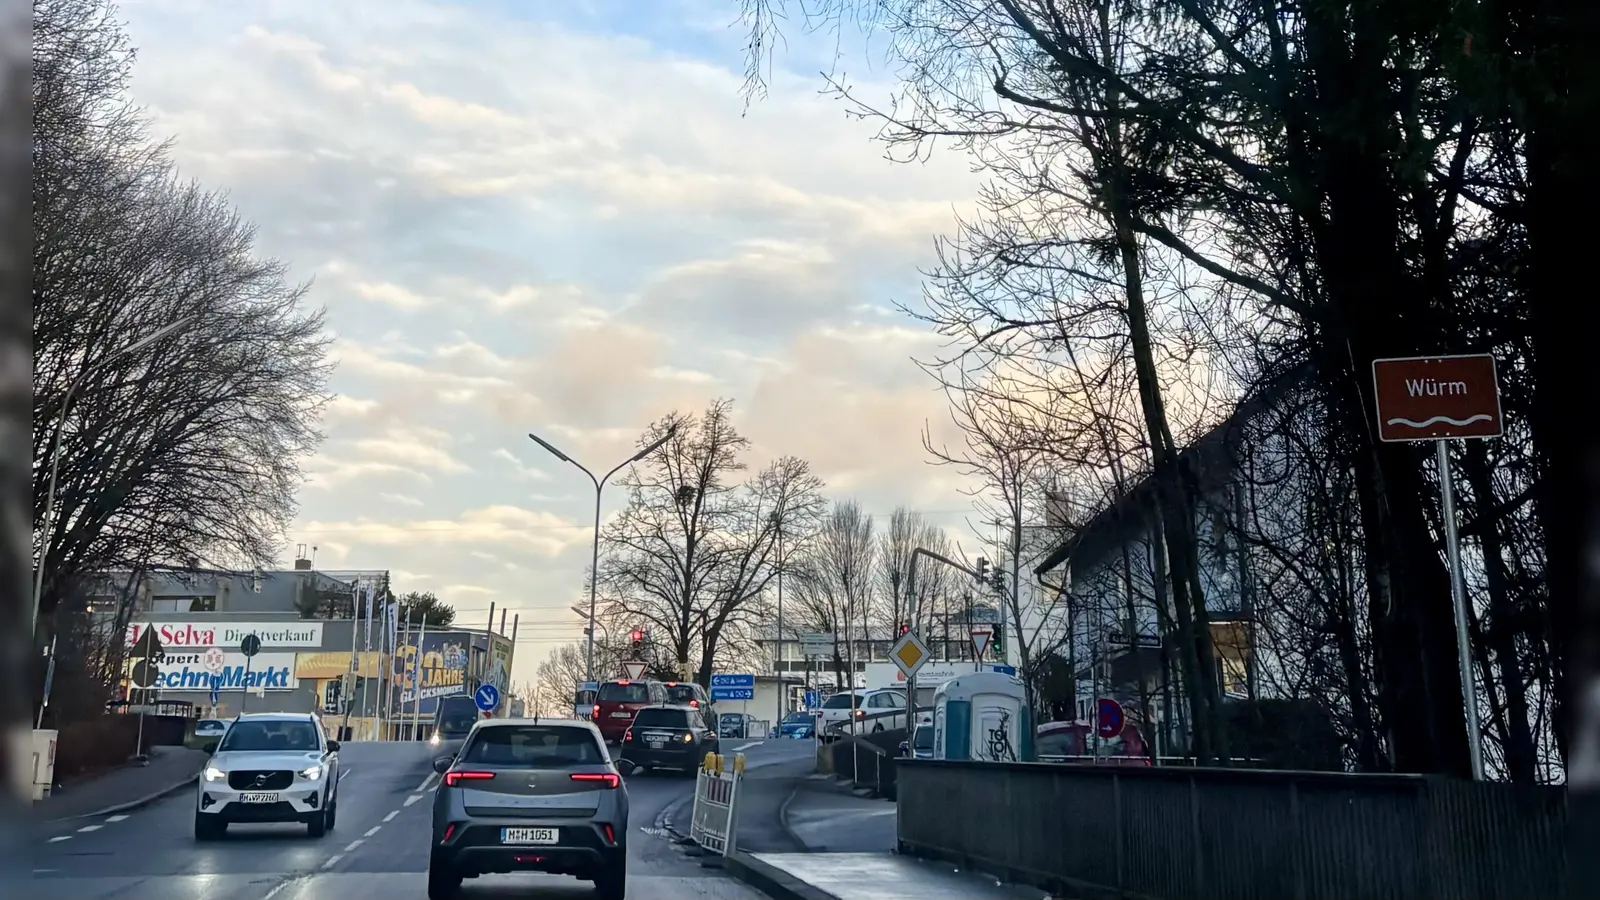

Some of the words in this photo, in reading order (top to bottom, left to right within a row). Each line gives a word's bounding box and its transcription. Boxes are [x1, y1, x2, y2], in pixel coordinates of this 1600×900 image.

[1405, 378, 1467, 397] Würm
[160, 624, 214, 645] Selva
[423, 668, 465, 689] JAHRE
